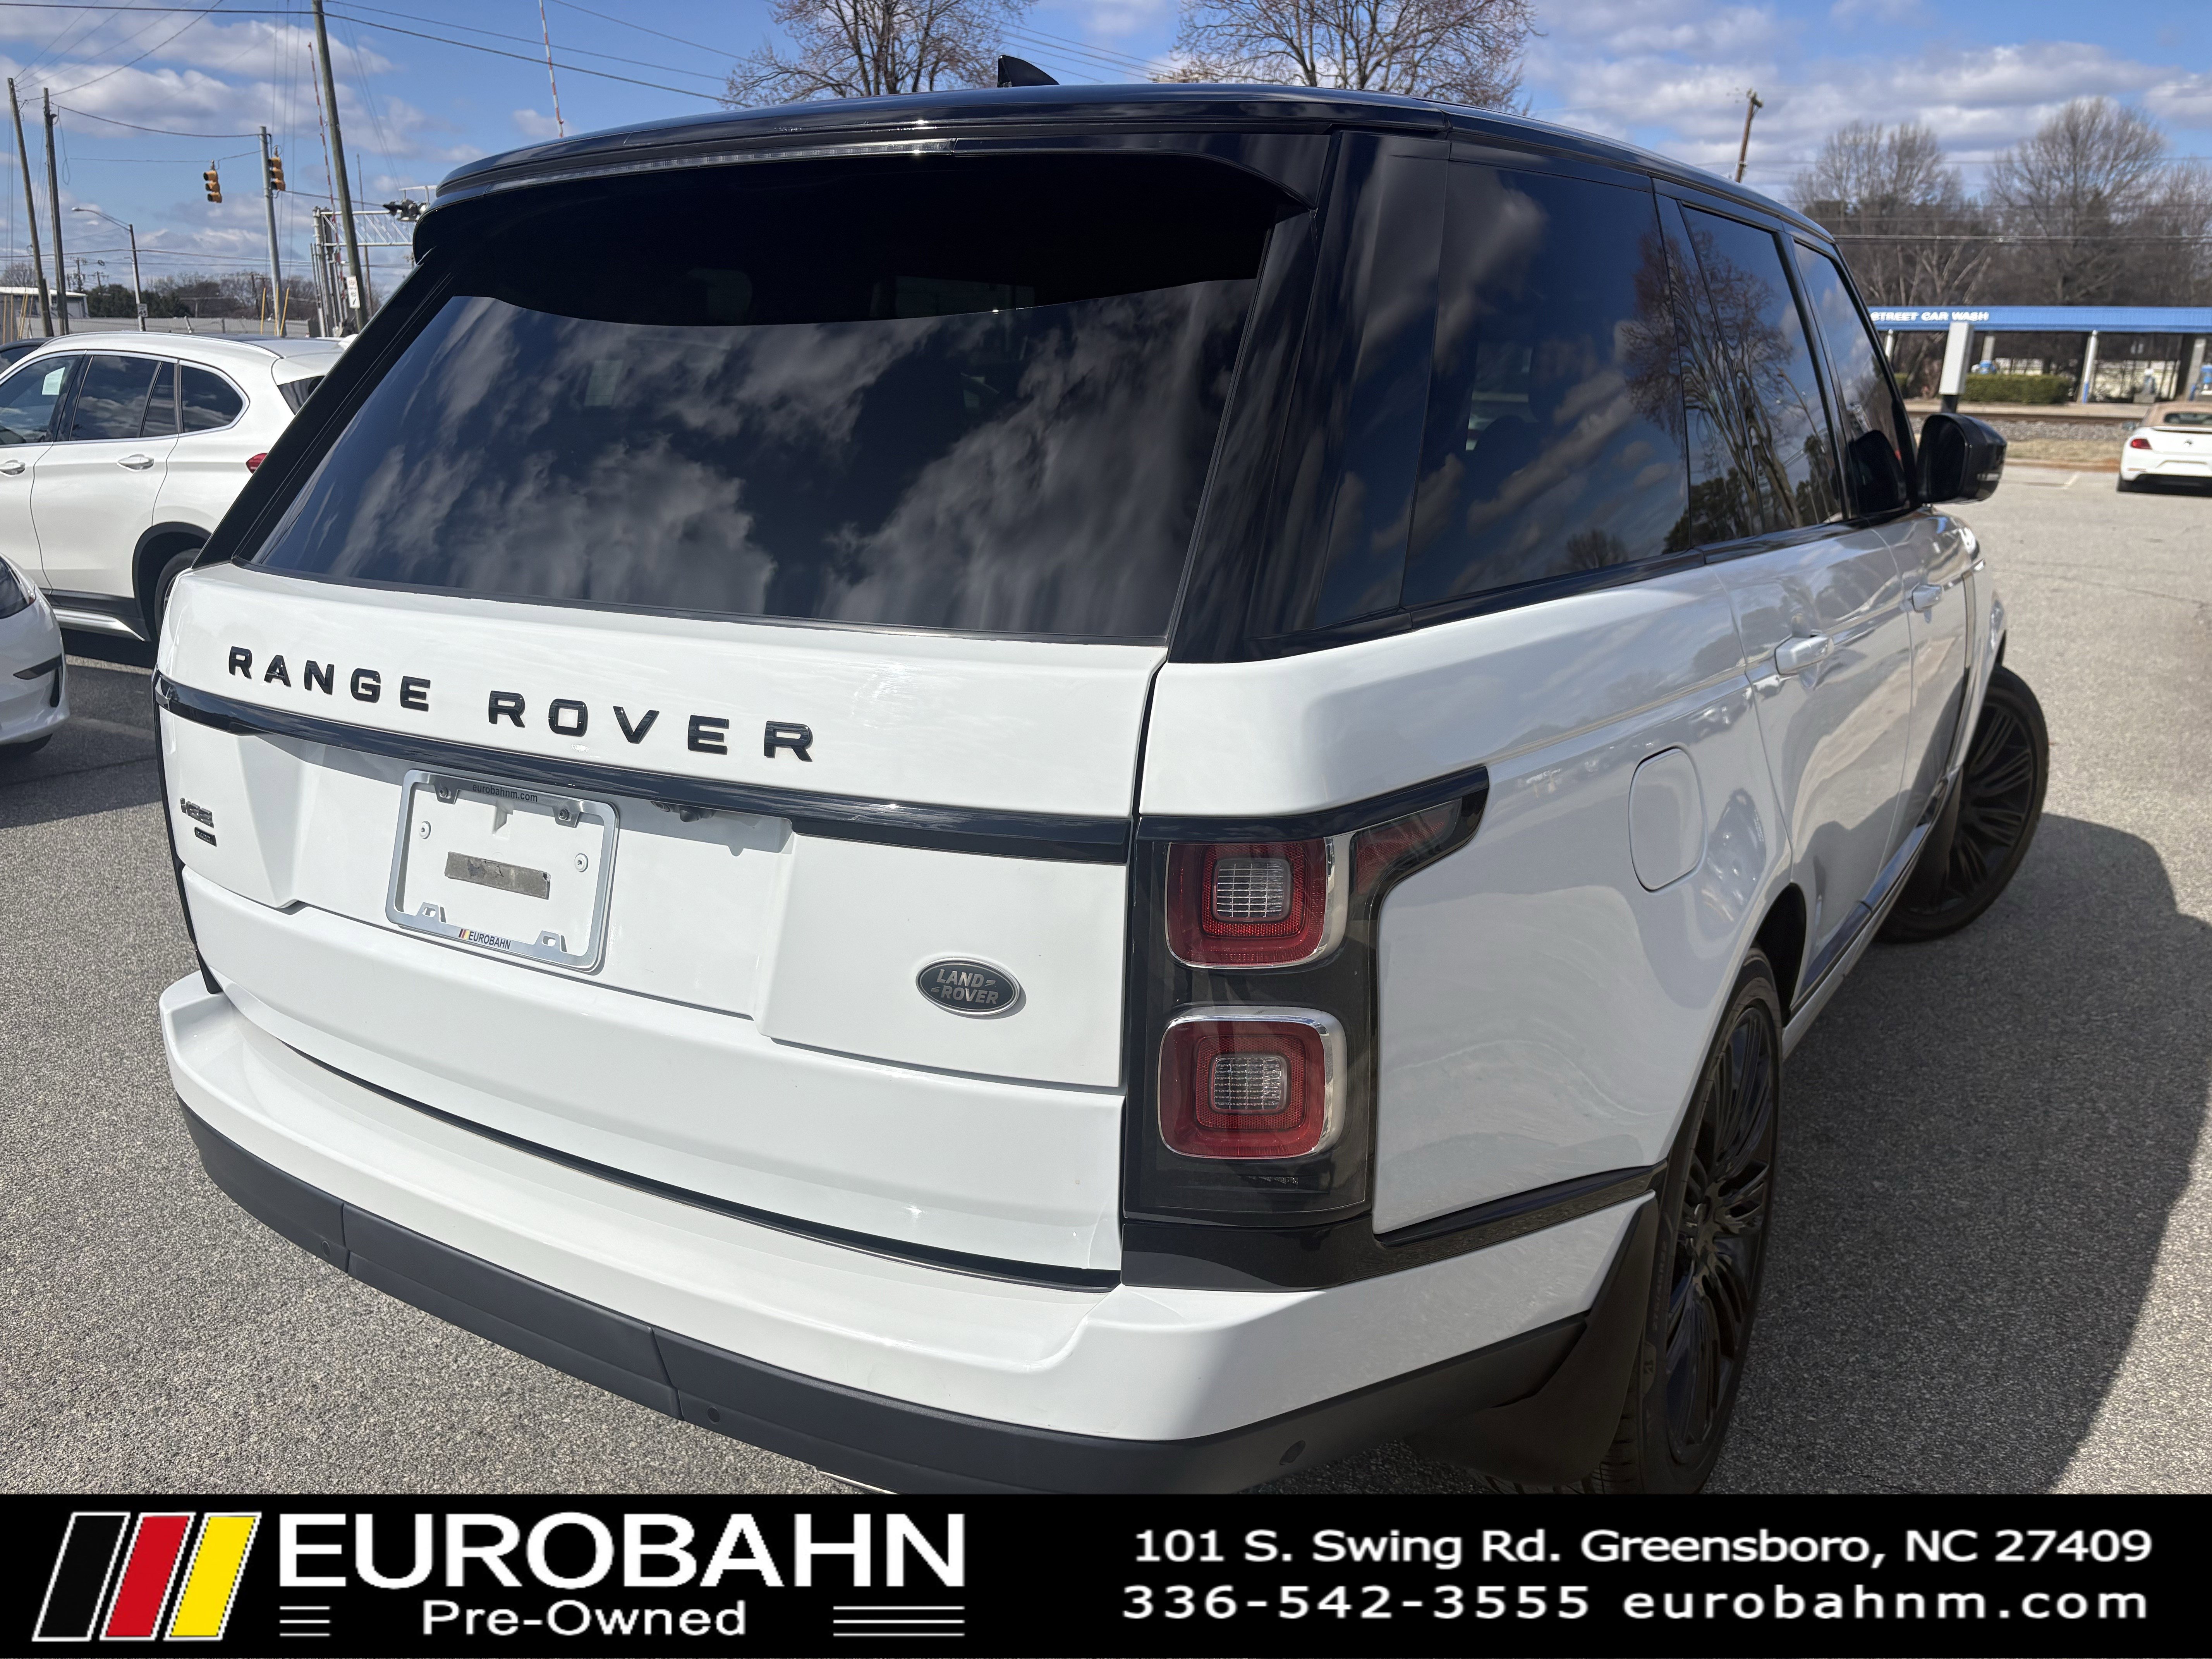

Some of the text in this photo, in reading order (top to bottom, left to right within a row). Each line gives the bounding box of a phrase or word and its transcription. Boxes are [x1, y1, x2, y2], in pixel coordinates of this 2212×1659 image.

[1870, 312, 1989, 321] STREET CAR WASH
[228, 646, 812, 762] RANGE ROVER
[472, 784, 538, 802] eurobahnm.com
[468, 931, 511, 950] EUROBAHN
[936, 969, 984, 988] LAND
[940, 985, 999, 1005] ROVER
